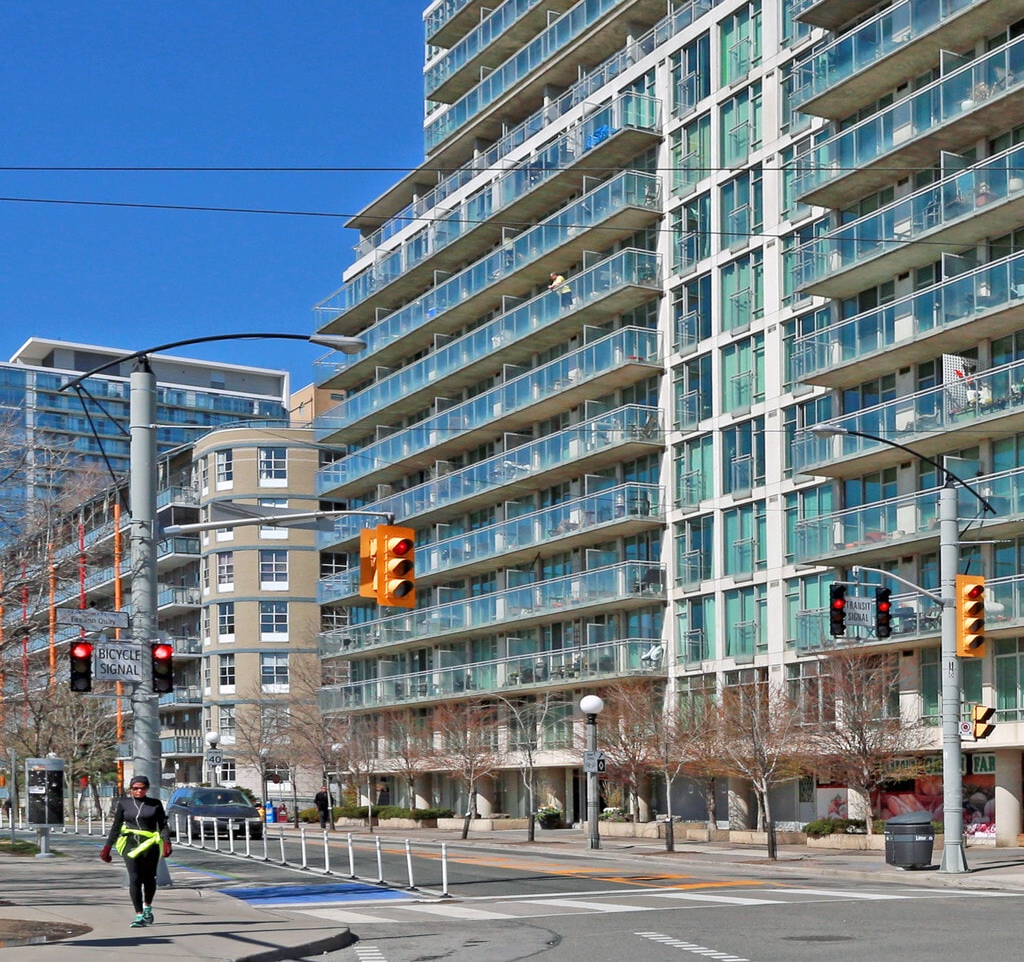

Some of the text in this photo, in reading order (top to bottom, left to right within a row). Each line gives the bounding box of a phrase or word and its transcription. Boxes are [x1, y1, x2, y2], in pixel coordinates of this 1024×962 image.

[846, 601, 870, 610] TRANSIT
[848, 613, 869, 622] SIGNAL
[98, 649, 140, 661] BICYCLE
[100, 663, 140, 675] SIGNAL
[973, 755, 996, 773] FAR
